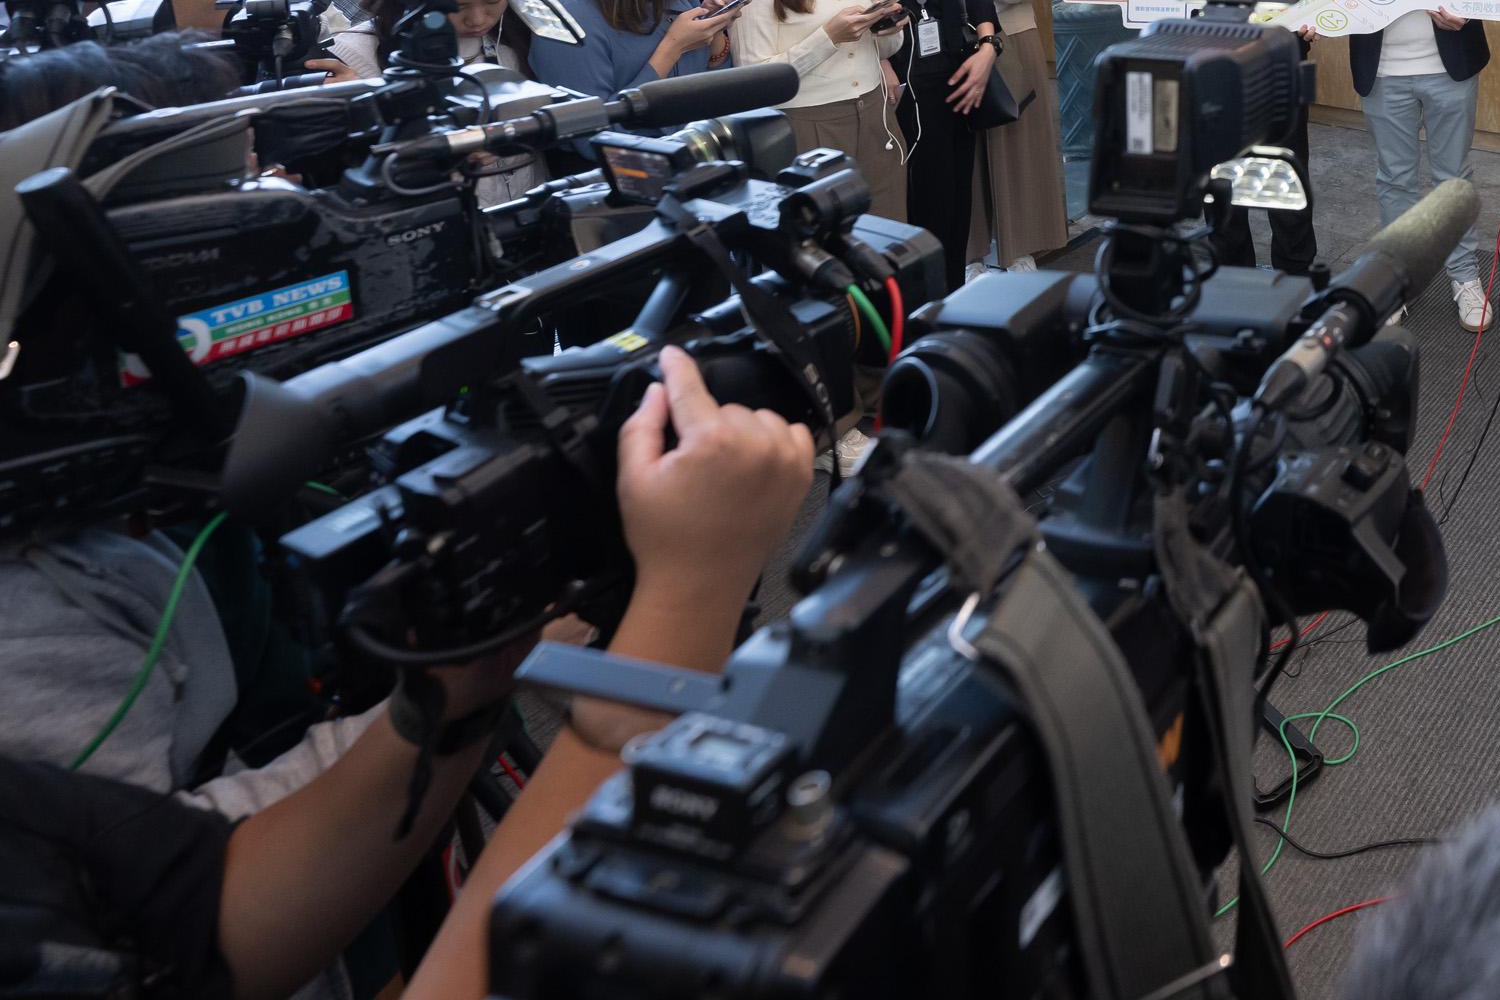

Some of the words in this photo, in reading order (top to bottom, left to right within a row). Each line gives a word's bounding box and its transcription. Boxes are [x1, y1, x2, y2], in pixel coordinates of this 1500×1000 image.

[387, 221, 446, 247] SONY
[210, 300, 264, 325] TVB
[272, 276, 343, 307] NEWS
